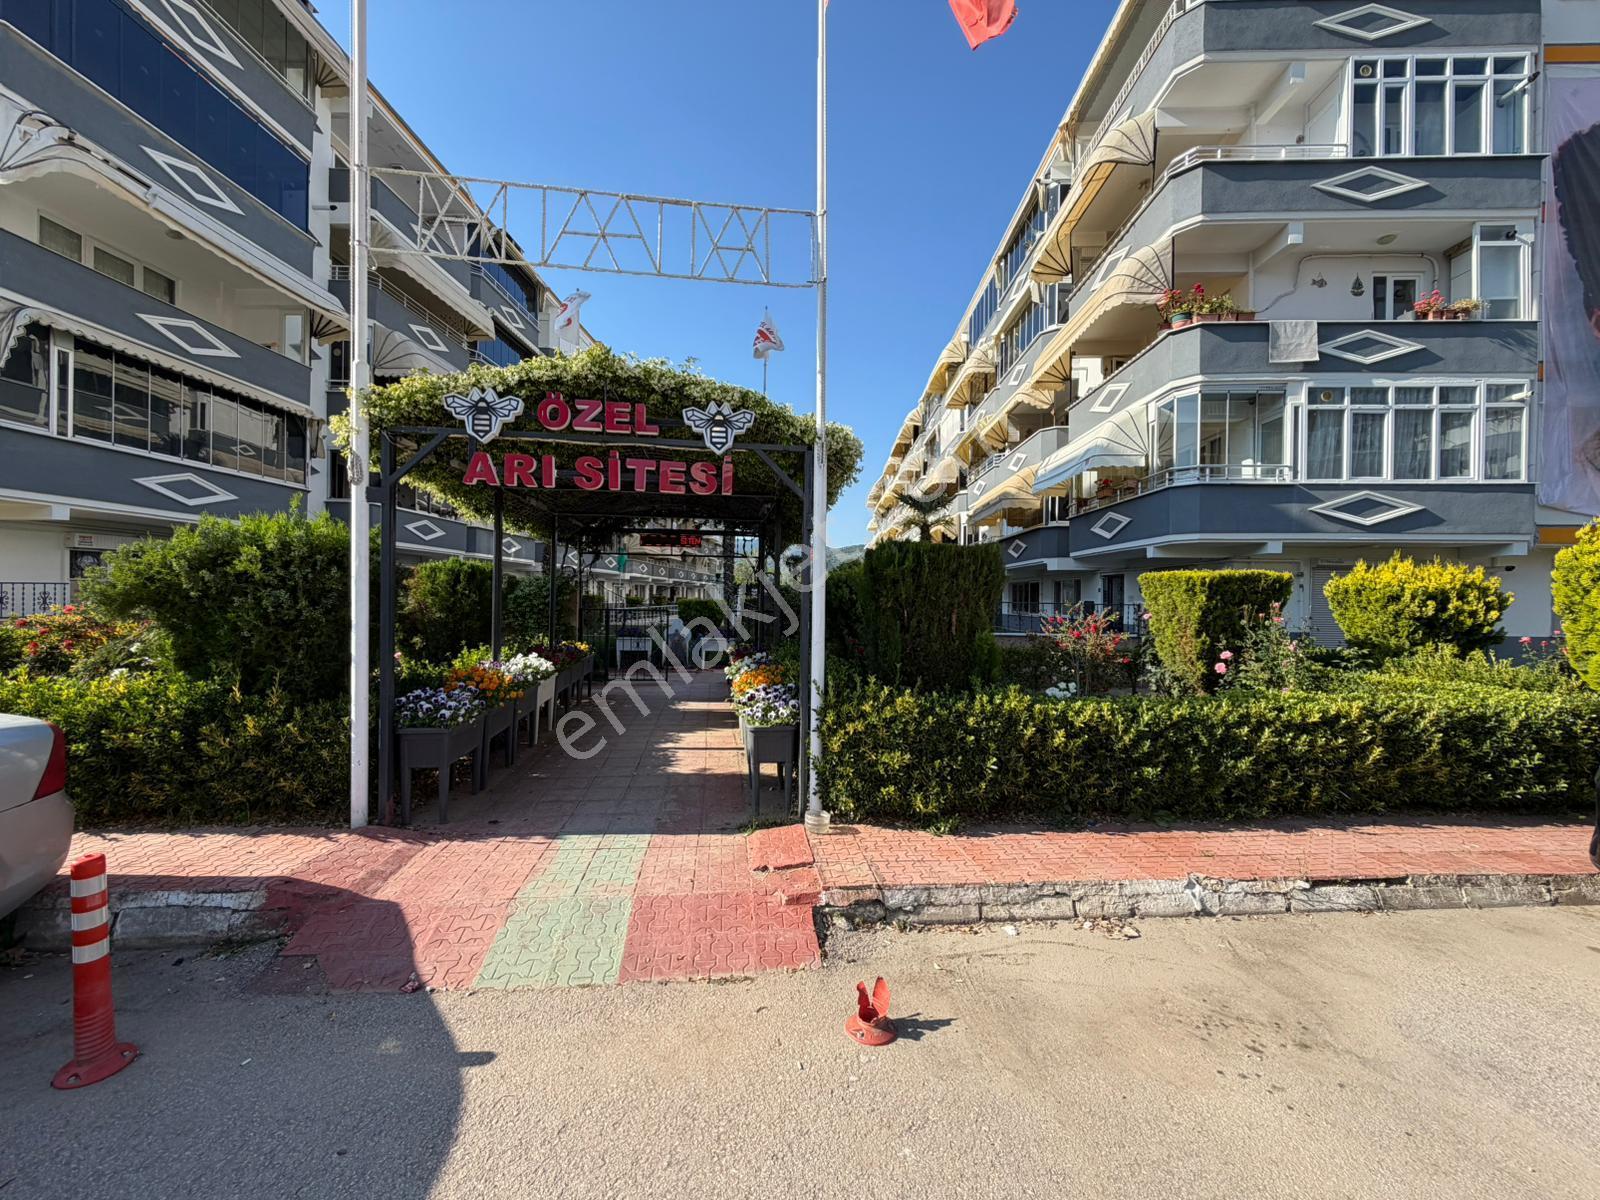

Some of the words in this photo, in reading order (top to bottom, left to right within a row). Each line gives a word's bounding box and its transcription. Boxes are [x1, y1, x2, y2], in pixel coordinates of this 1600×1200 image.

[537, 391, 660, 436] ÖZEL
[463, 452, 557, 488] ARI
[573, 450, 735, 496] SİTESİ
